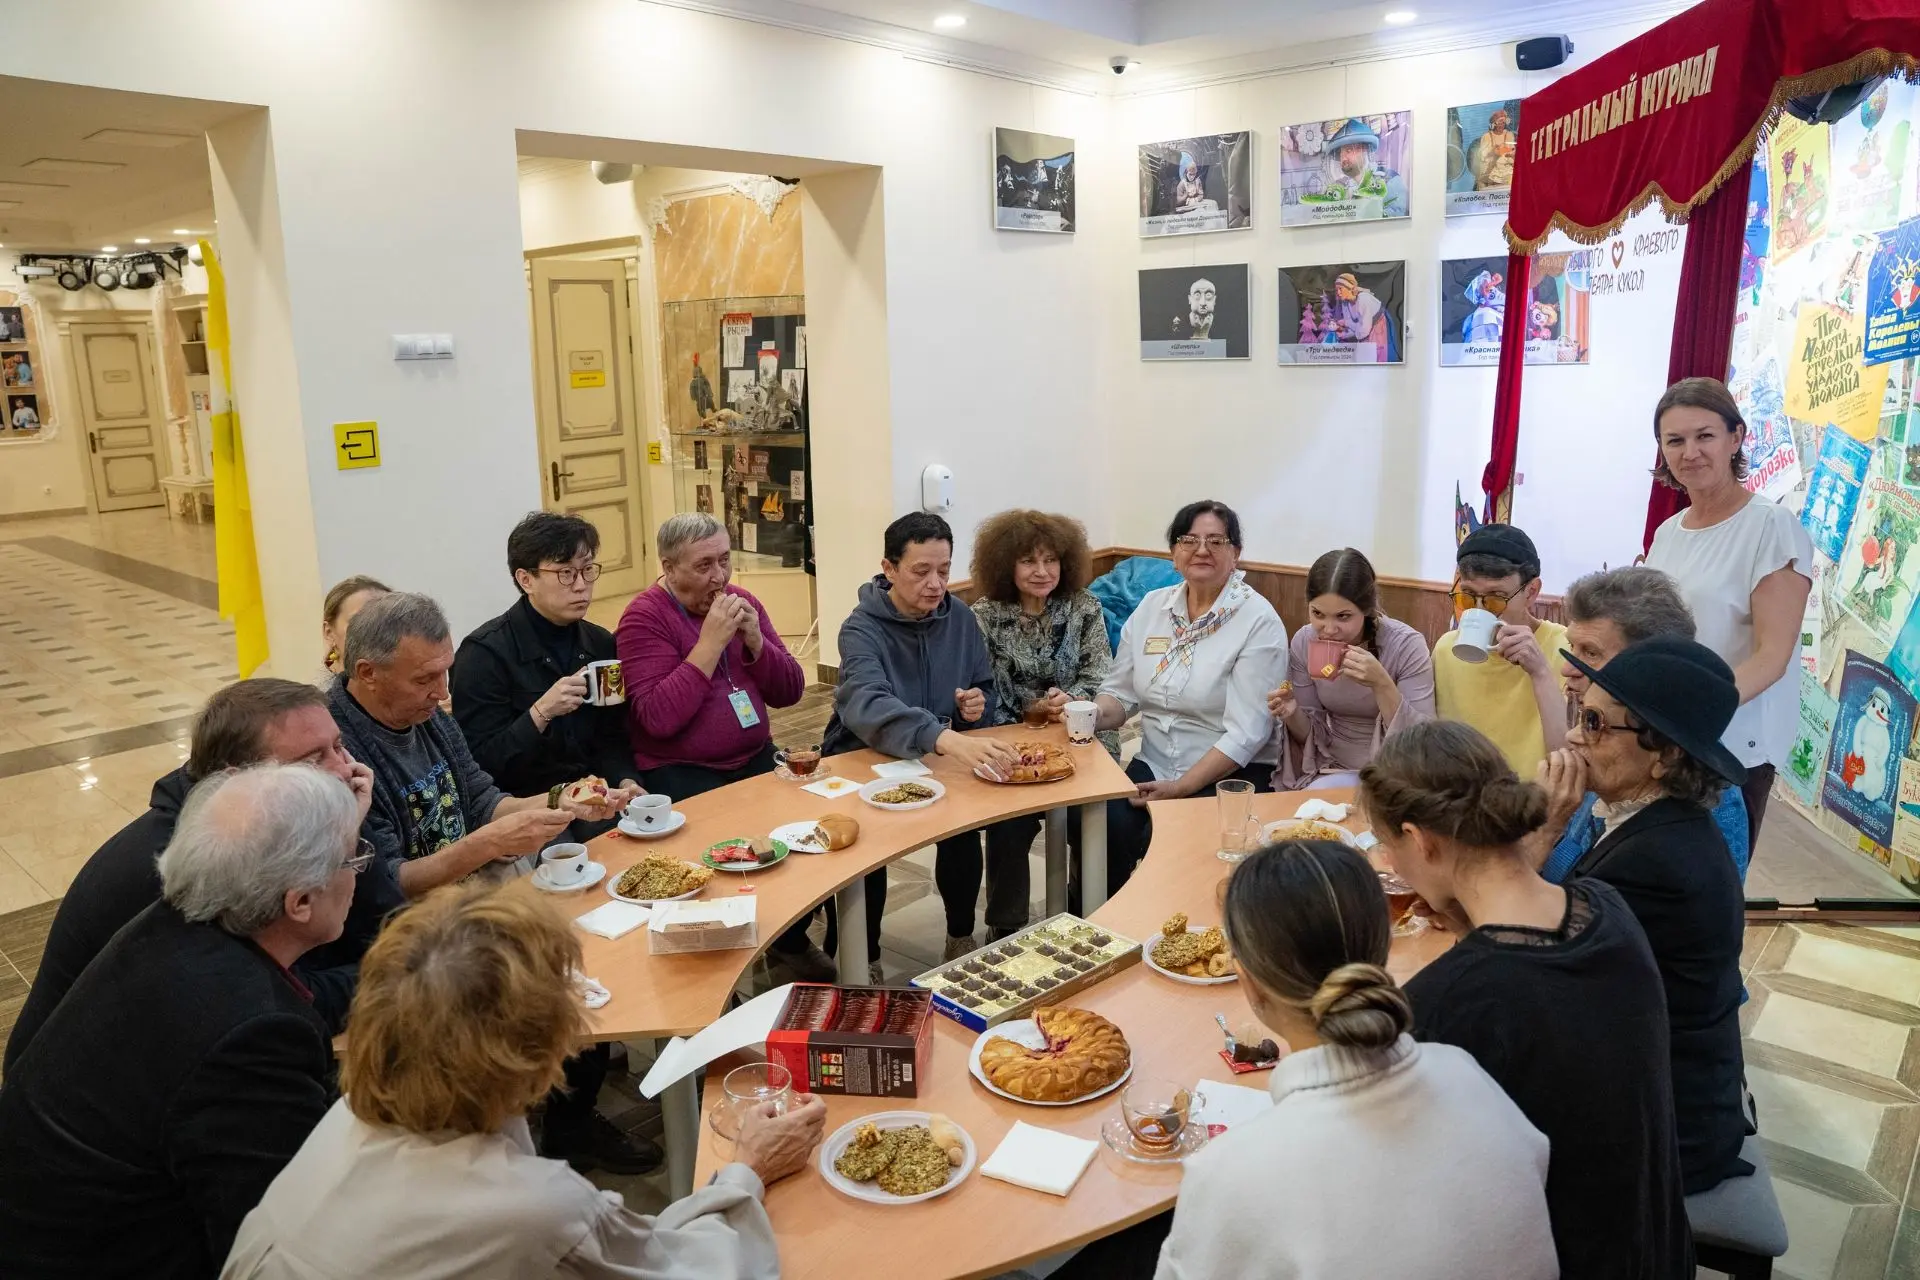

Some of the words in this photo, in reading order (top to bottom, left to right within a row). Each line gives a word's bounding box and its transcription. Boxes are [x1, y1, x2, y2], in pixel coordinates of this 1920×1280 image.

[1531, 73, 1638, 163] ТЕАТРАЛЬНЫЙ
[1640, 45, 1719, 119] ЖУРНАЛ
[1633, 228, 1679, 257] КРАЕВОГО
[1617, 269, 1644, 292] КУКОЛ
